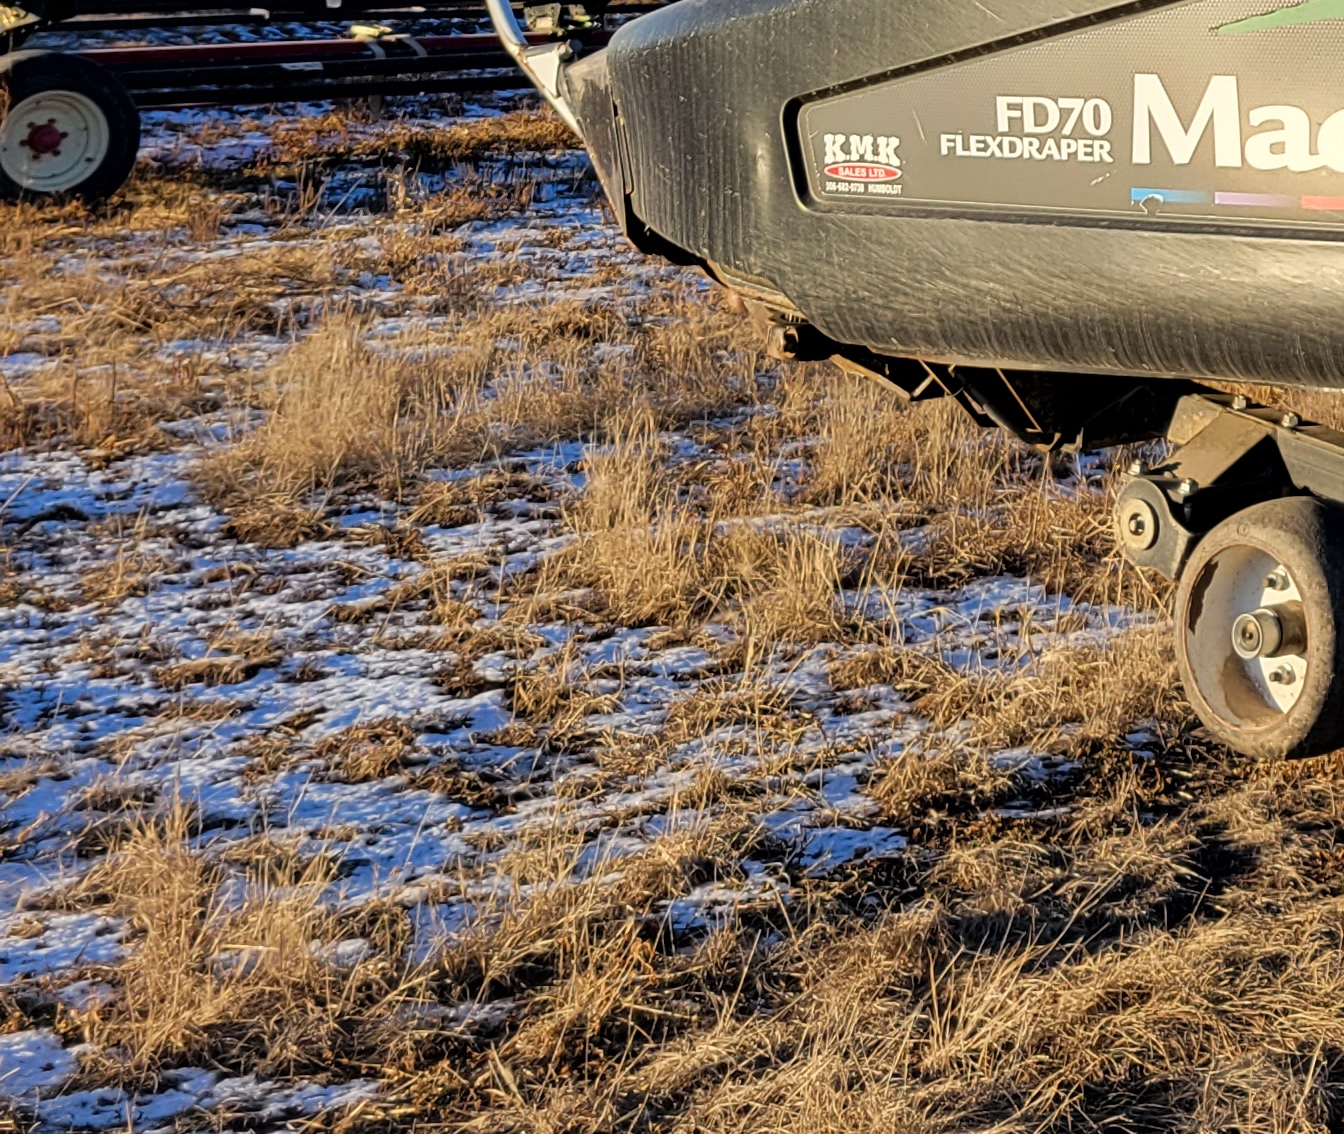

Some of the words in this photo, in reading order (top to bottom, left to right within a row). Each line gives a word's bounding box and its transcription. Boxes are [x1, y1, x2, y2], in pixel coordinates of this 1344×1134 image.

[996, 96, 1112, 137] FD70
[940, 133, 1113, 163] FLEXDRAPER
[837, 166, 867, 178] SALES
[868, 183, 902, 195] HUMBOLDT
